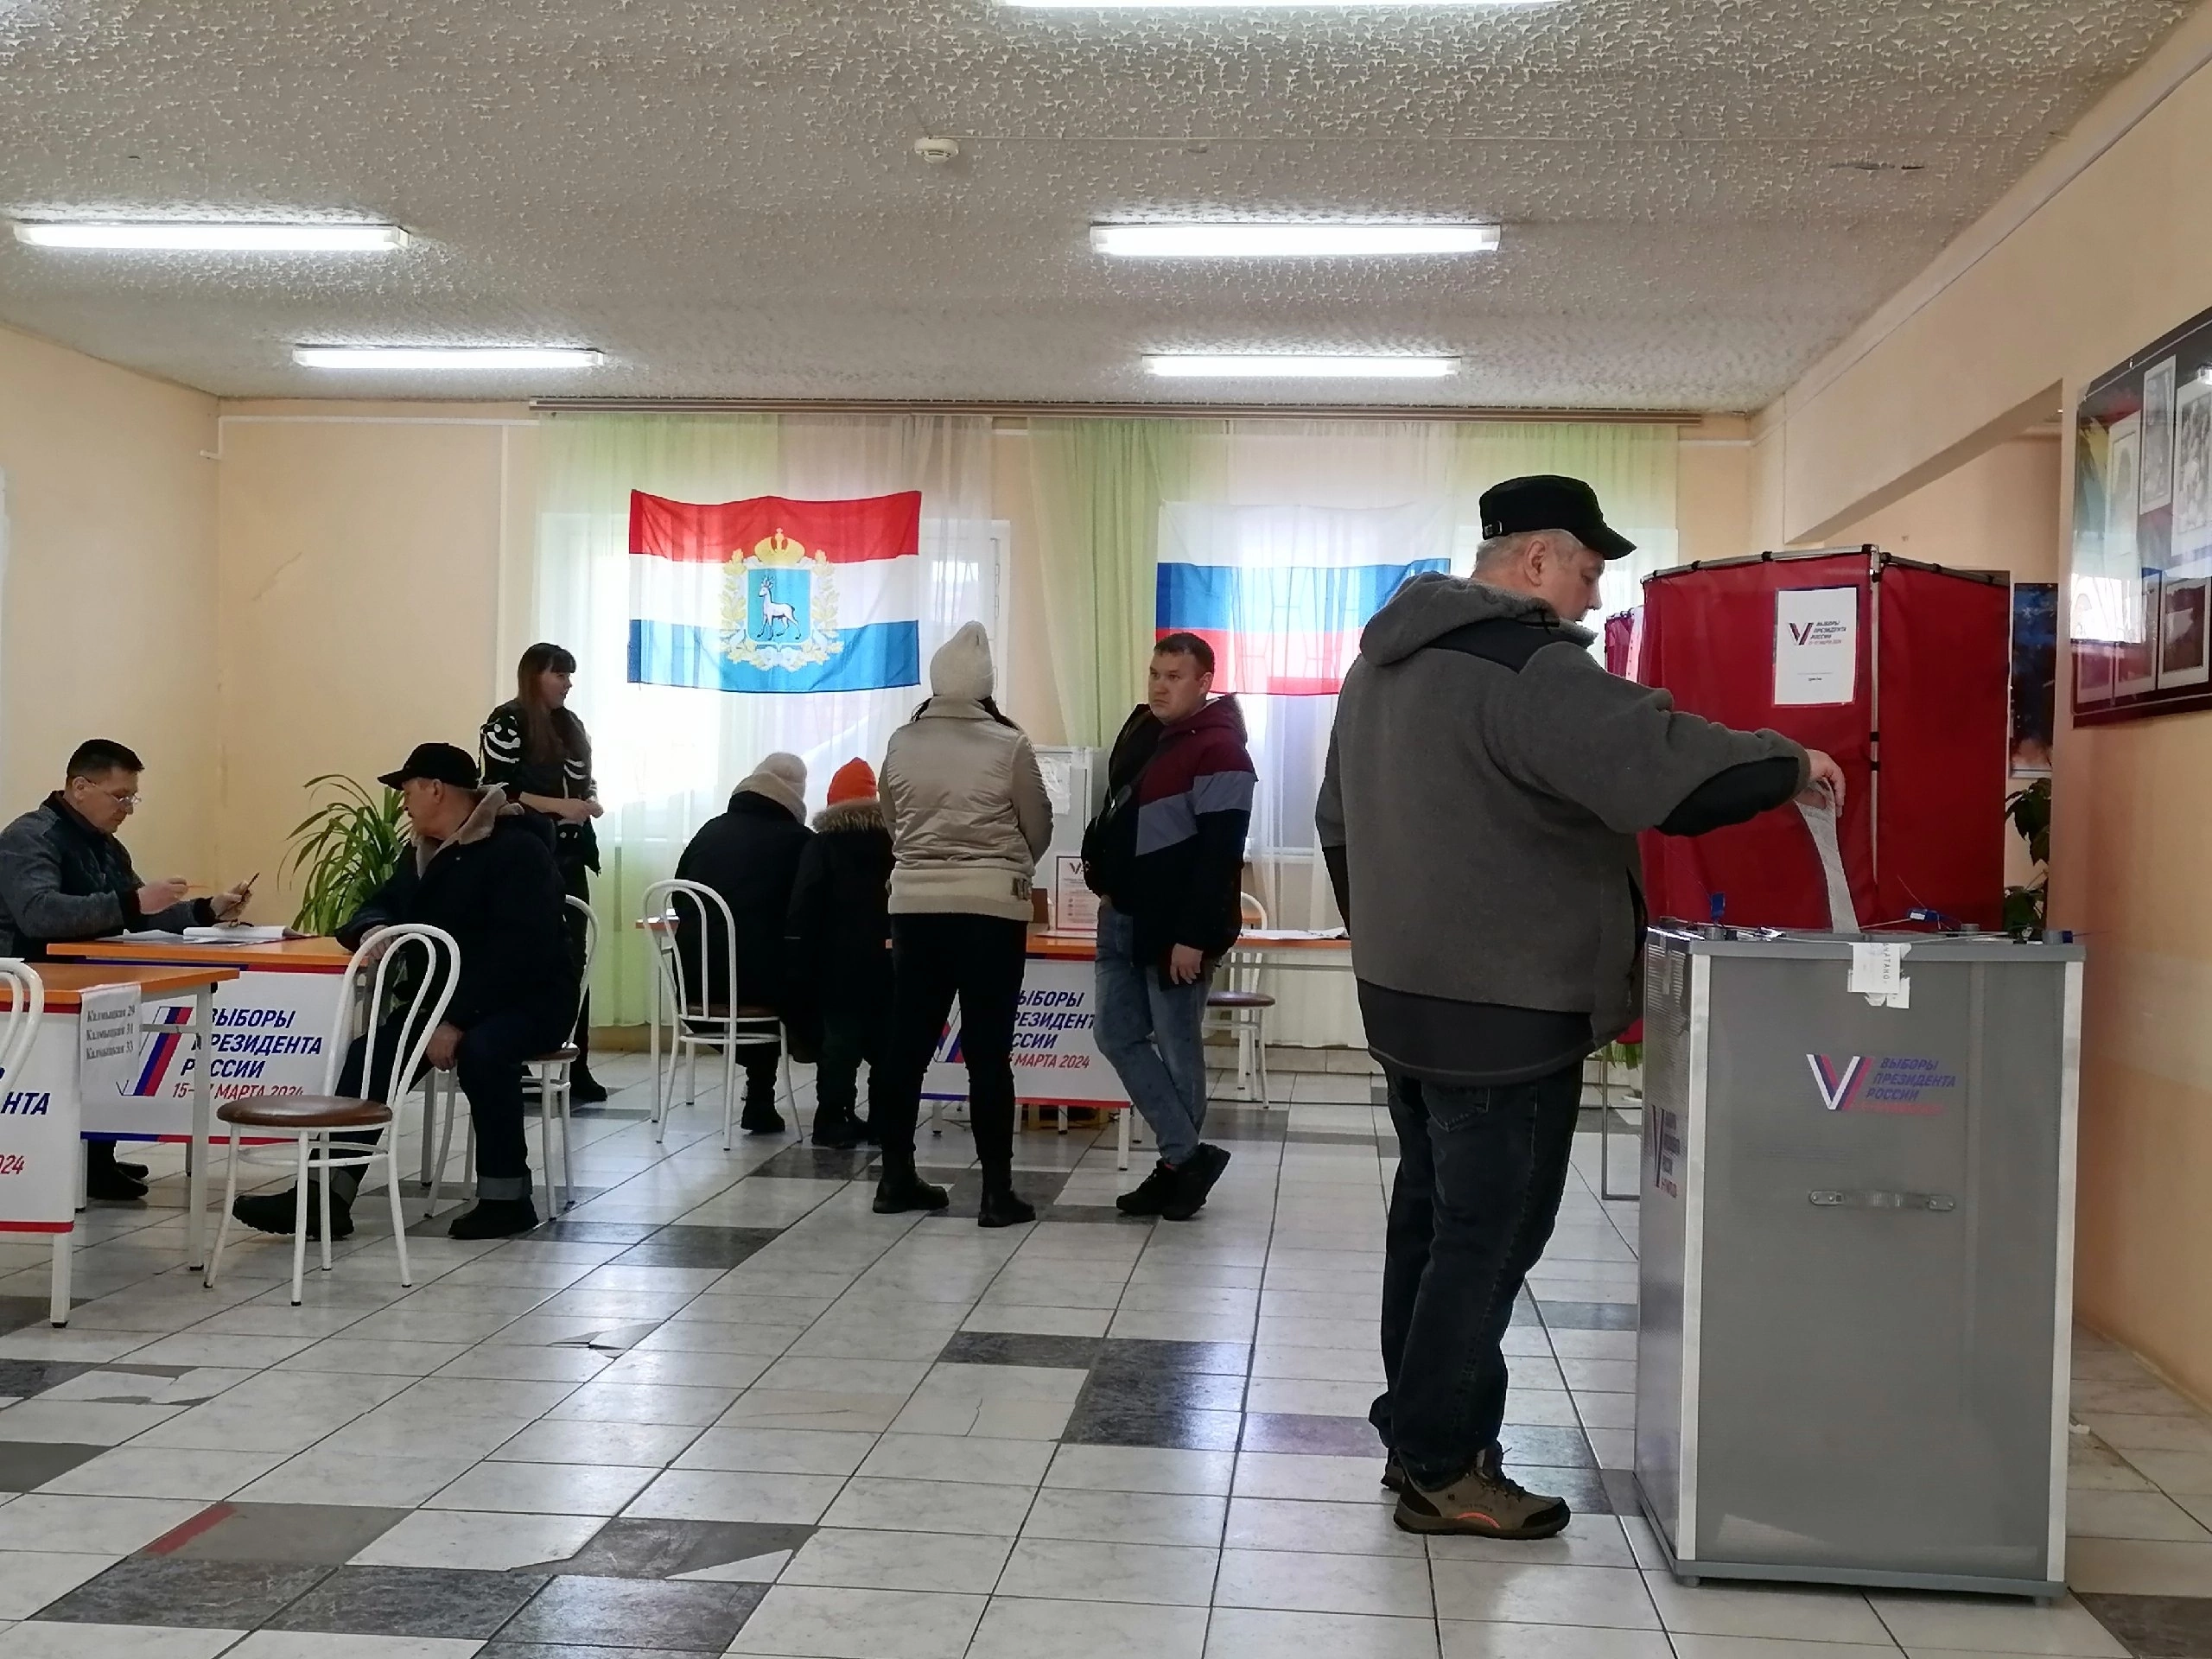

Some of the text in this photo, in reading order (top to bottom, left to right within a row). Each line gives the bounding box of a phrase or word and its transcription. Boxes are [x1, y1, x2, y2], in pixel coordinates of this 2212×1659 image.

[1018, 990, 1084, 1007] ЫБОРЫ
[1015, 1012, 1095, 1030] РЕЗИДЕНТ
[191, 1033, 322, 1056] РЕЗИДЕНТА
[1013, 1033, 1058, 1049] ССИИ
[181, 1058, 265, 1078] РССИИ
[1014, 1053, 1057, 1067] МАРТА
[1058, 1055, 1090, 1068] 2024
[1880, 1057, 1939, 1071] ВЫБОРЫ
[1872, 1072, 1956, 1088] ПРЕЗИДЕНТА
[0, 1091, 50, 1115] НТА
[1866, 1088, 1920, 1102] РОССИИ
